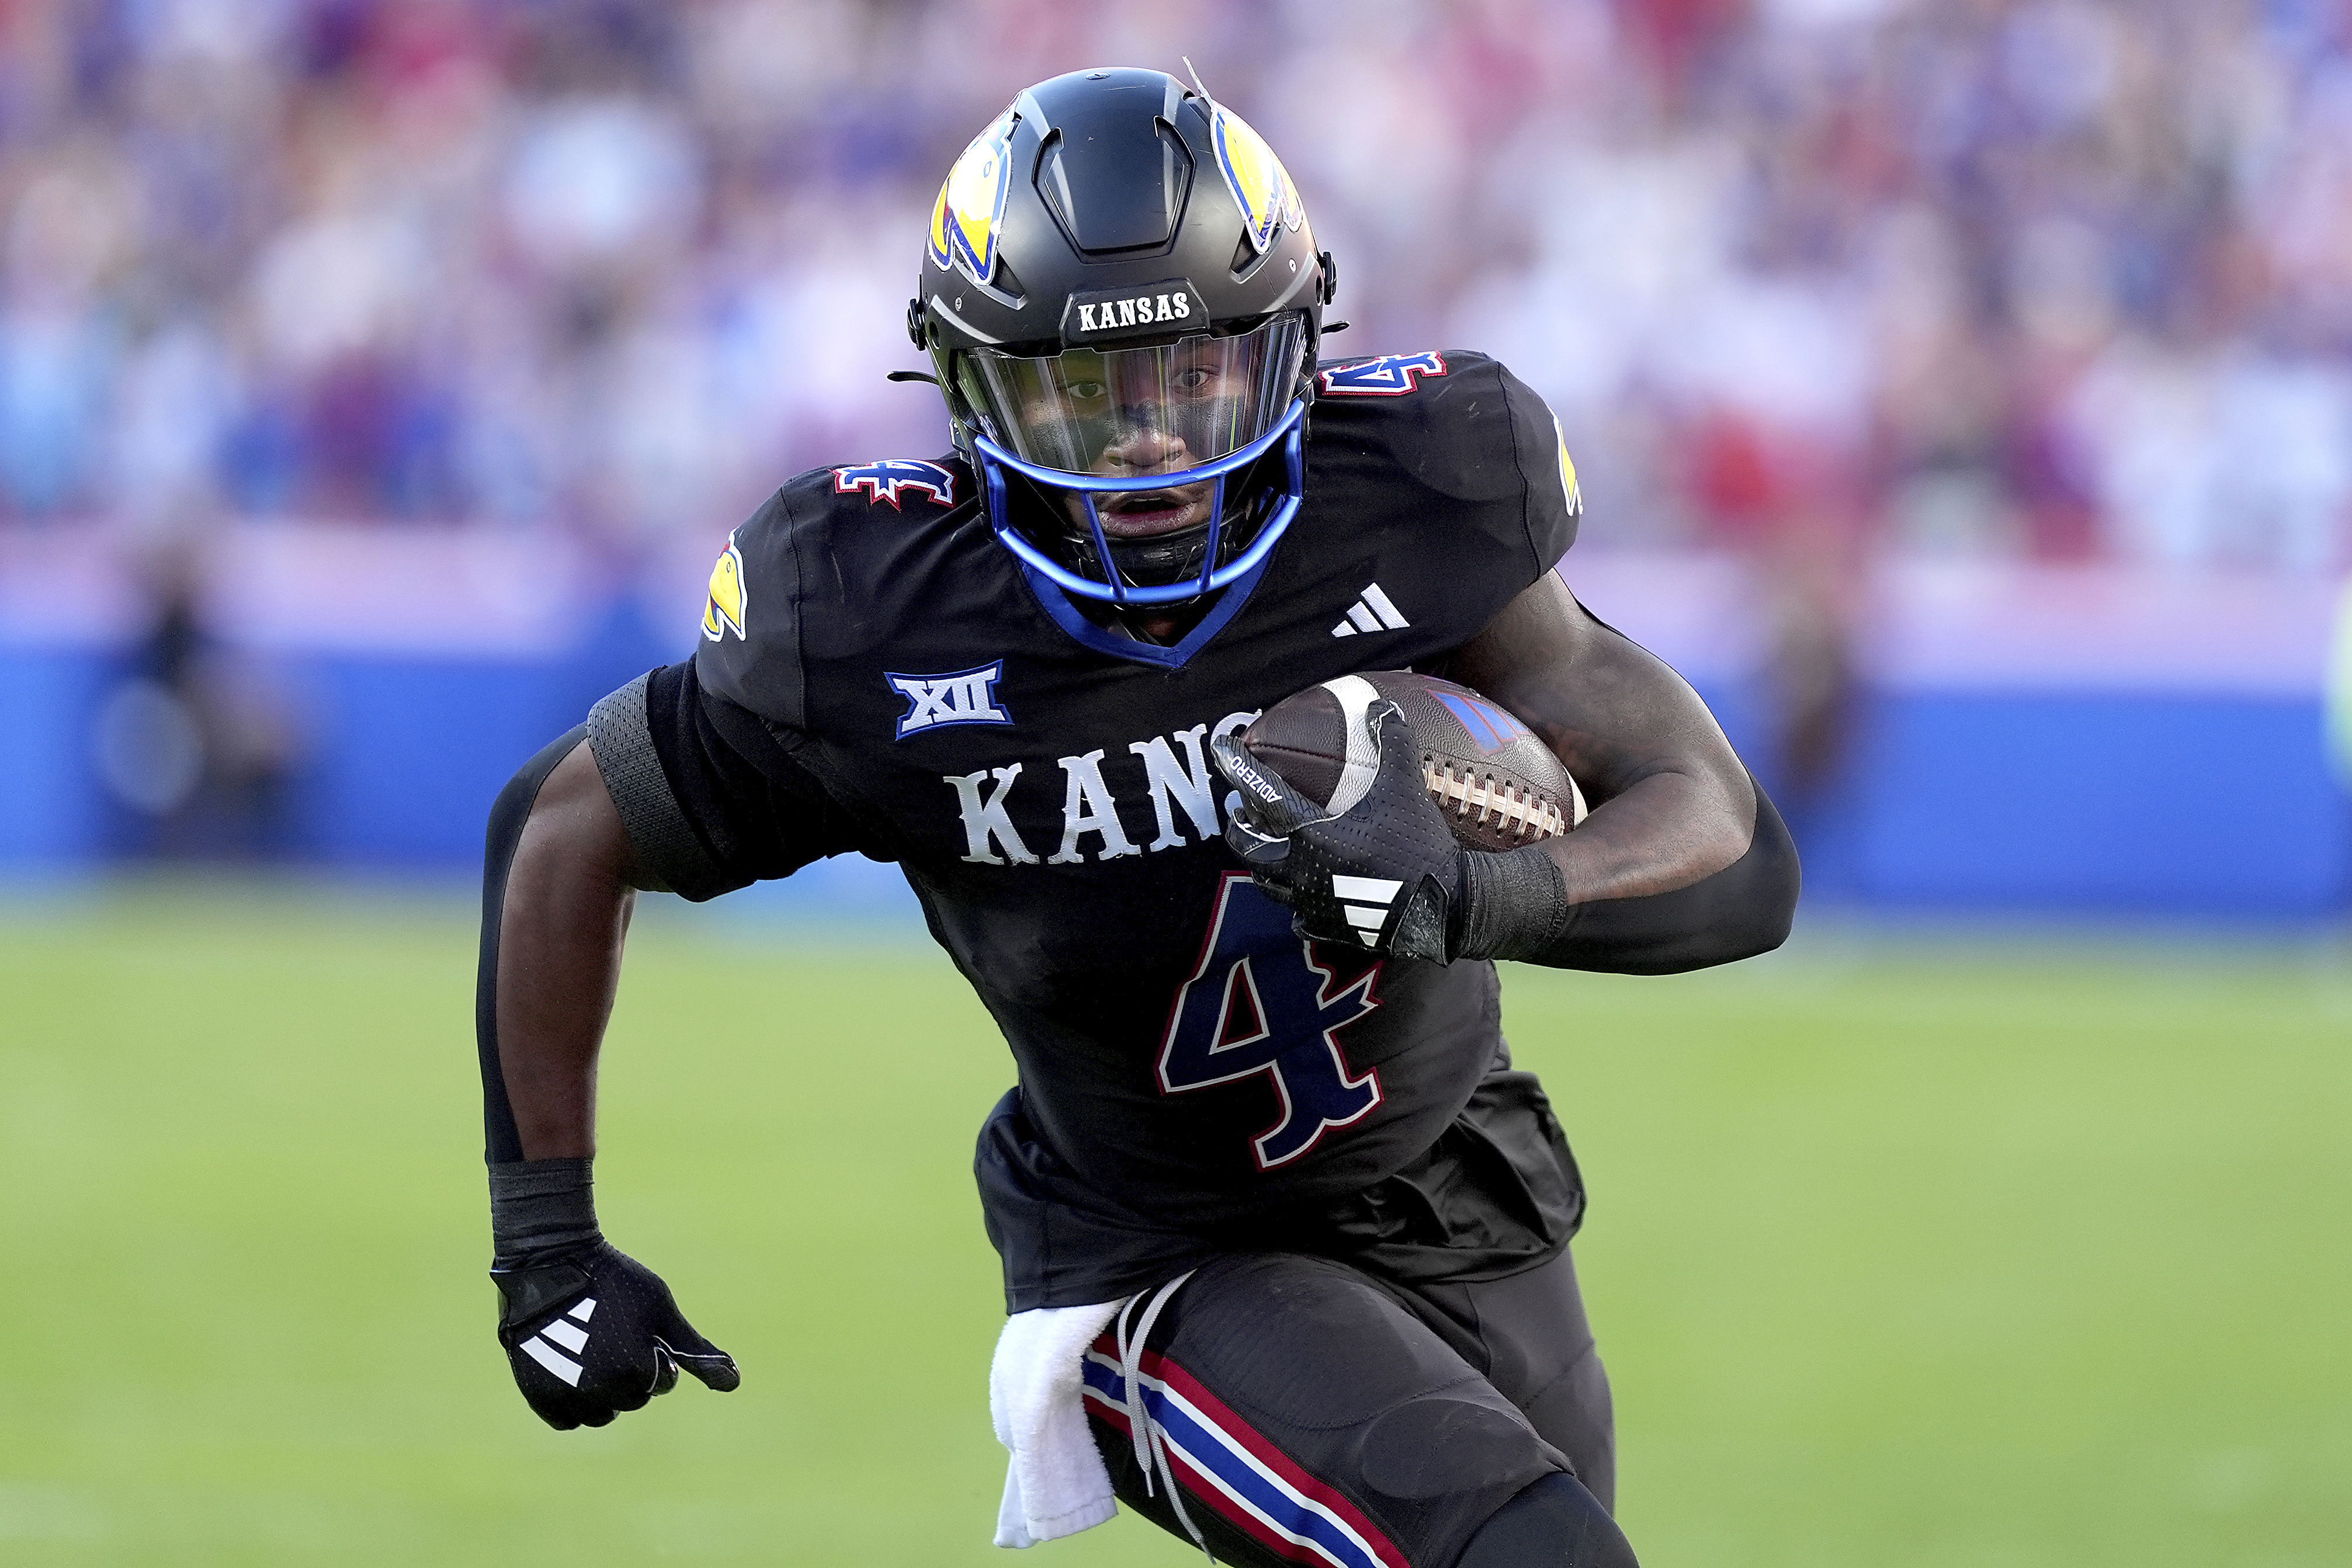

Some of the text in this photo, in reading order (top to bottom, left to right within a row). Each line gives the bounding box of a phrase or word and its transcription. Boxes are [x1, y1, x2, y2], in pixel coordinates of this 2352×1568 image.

[1079, 292, 1190, 331] KANSAS
[1230, 755, 1283, 803] ADIZERO
[1154, 870, 1384, 1172] 4
